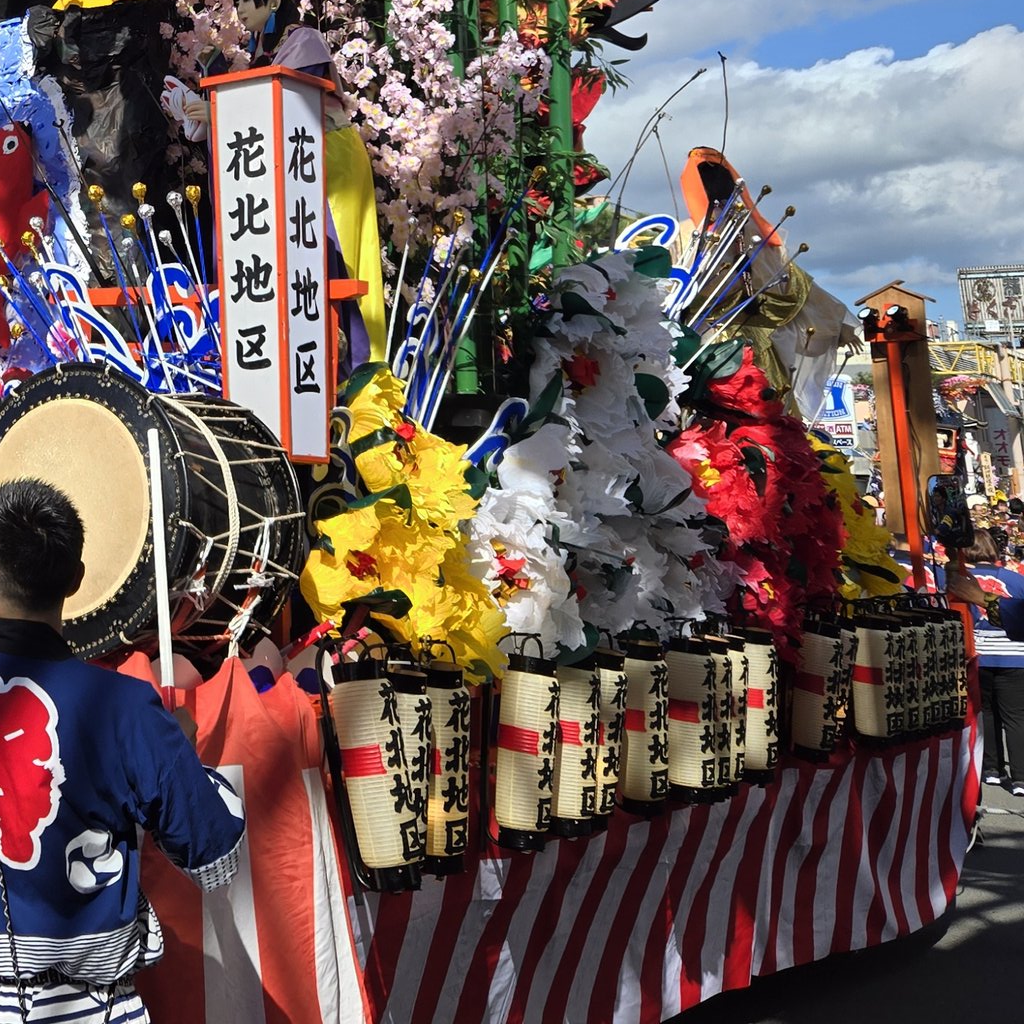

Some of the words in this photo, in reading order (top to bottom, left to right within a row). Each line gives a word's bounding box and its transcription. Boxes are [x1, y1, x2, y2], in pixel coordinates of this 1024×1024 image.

[226, 126, 276, 370] 花北地区
[288, 126, 322, 395] 花北地区
[836, 425, 852, 434] ATM
[378, 682, 425, 861] 花北地区
[442, 691, 471, 854] 花北地区
[580, 675, 601, 817] 花北地区
[599, 675, 627, 813] 花北地区
[648, 664, 669, 799] 花北地区
[699, 658, 716, 787] 花北地区
